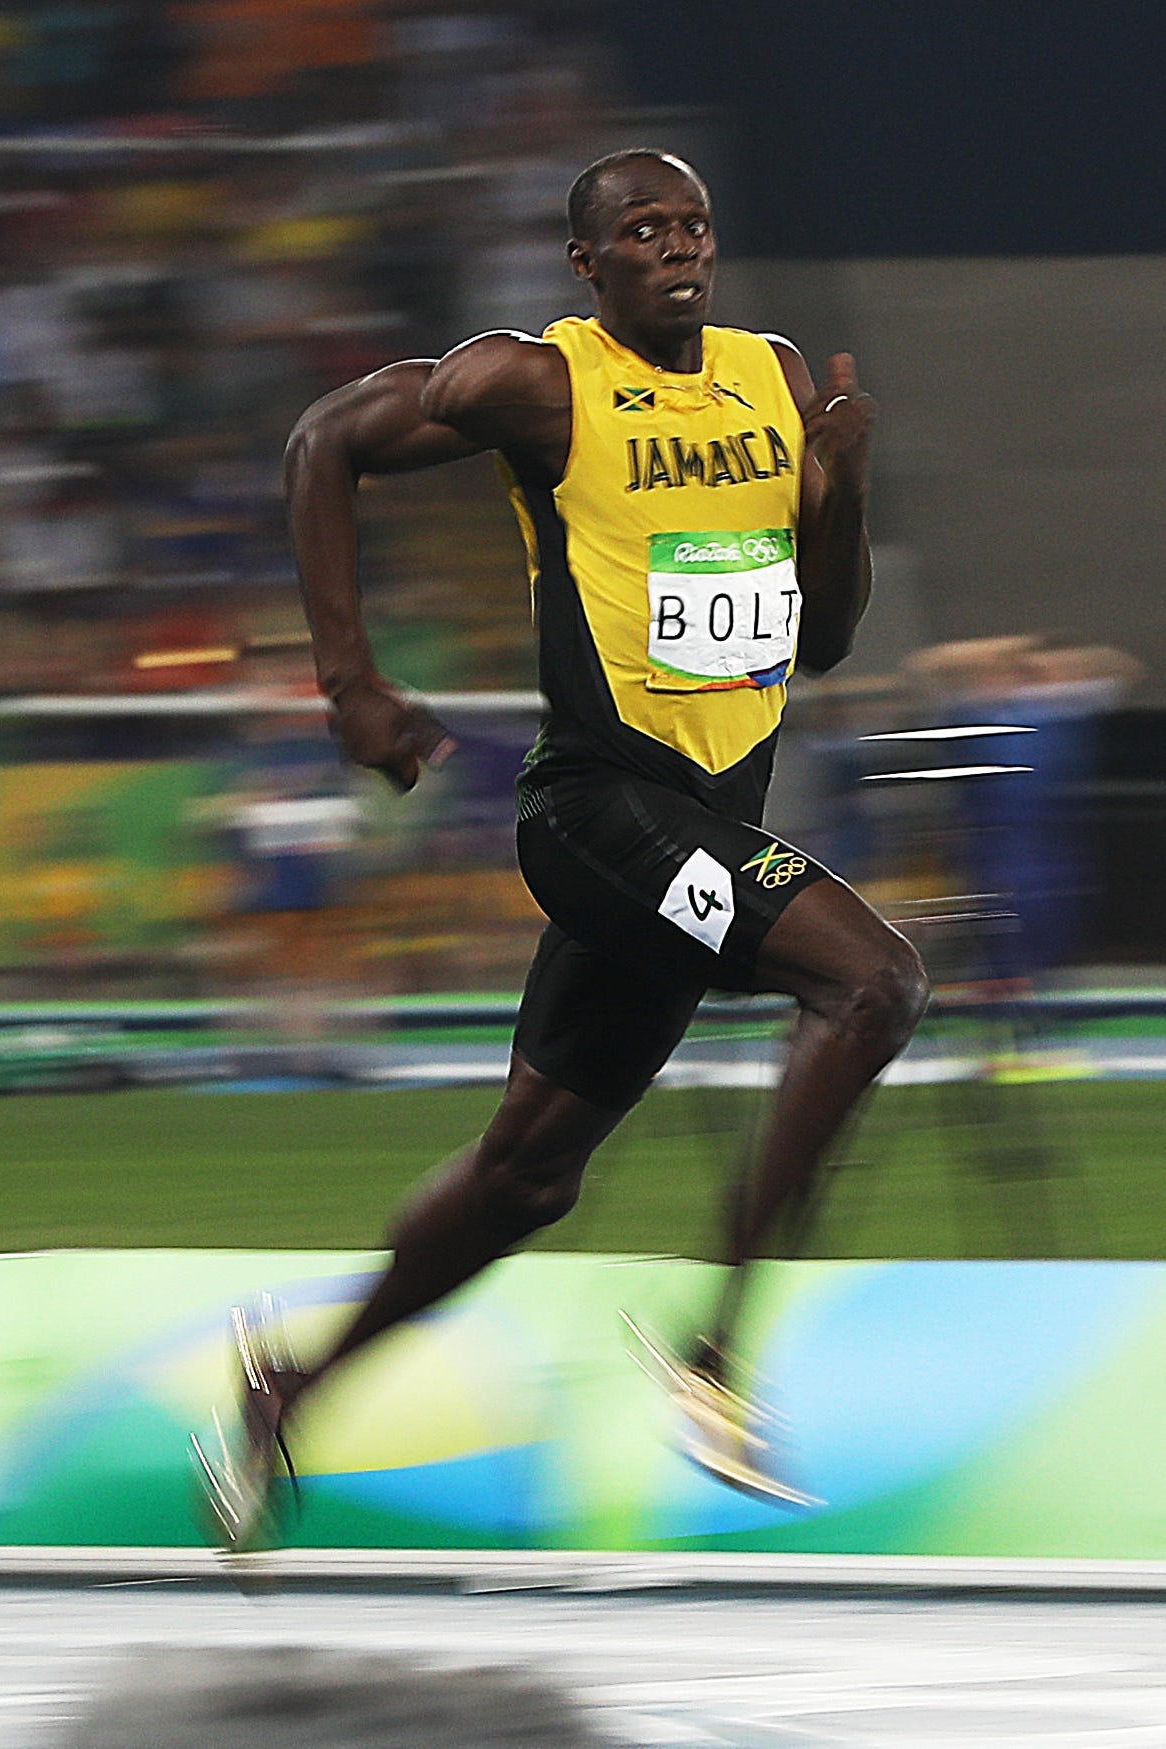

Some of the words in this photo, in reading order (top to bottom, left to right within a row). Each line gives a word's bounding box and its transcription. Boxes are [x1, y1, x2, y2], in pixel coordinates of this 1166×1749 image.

[626, 425, 794, 491] JAMAICA
[657, 590, 798, 642] BOLT
[687, 884, 724, 921] 4
